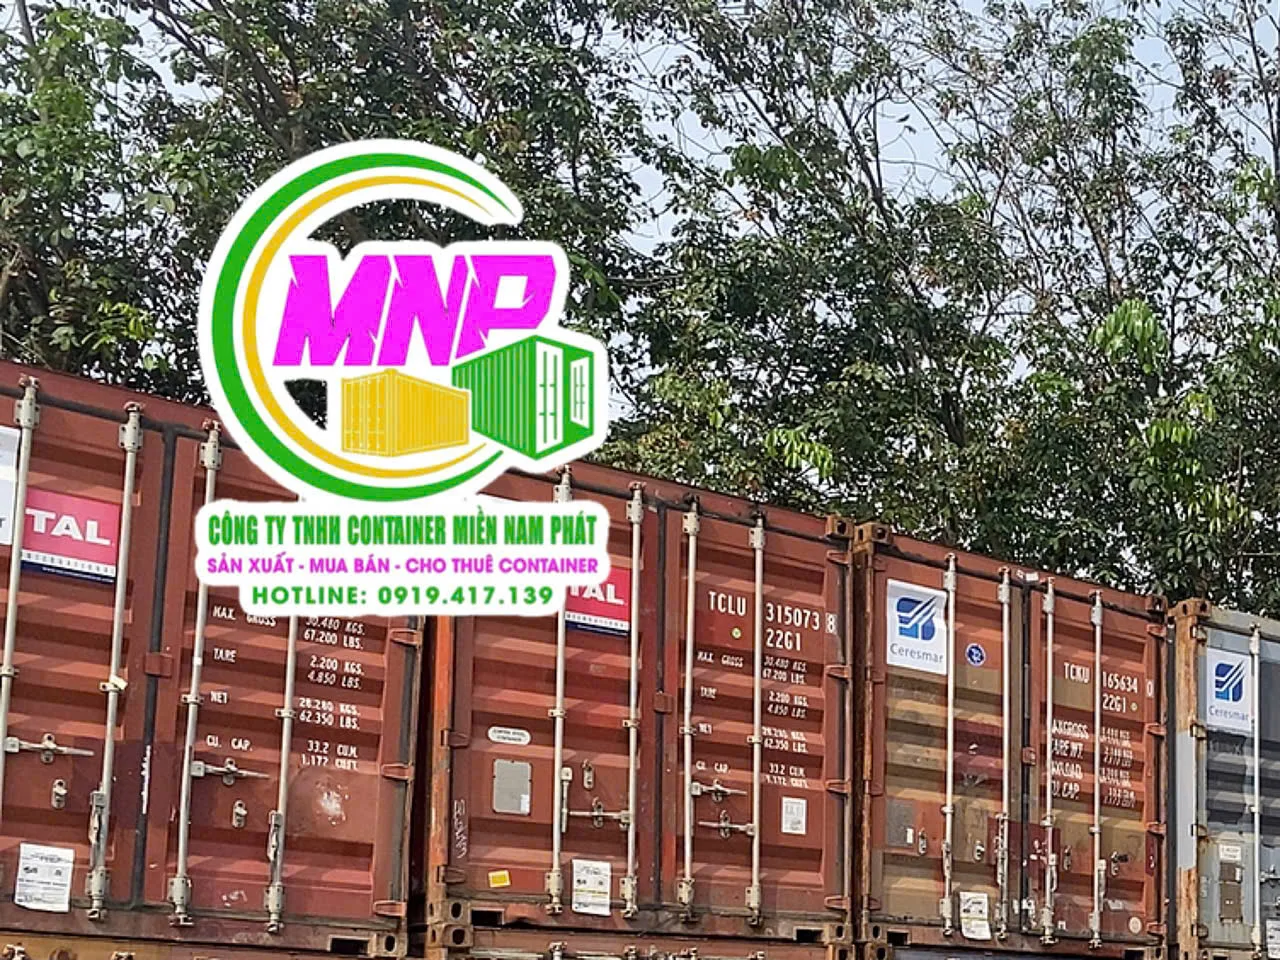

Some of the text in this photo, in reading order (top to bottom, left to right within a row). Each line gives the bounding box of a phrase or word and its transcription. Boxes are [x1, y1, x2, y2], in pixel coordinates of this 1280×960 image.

[25, 508, 111, 546] TAL
[708, 590, 838, 635] TCLU 315073 8
[345, 621, 366, 636] KGS.
[304, 629, 364, 650] 67.200 LBS.
[765, 627, 802, 652] 22G1
[213, 648, 238, 663] TARE
[310, 655, 338, 672] 2.200
[890, 643, 944, 664] Ceresmar
[341, 678, 363, 690] LBS.
[1101, 671, 1138, 694] 165634
[210, 691, 228, 704] NET
[1102, 694, 1127, 714] 22G1
[1208, 704, 1252, 722] Ceresmar
